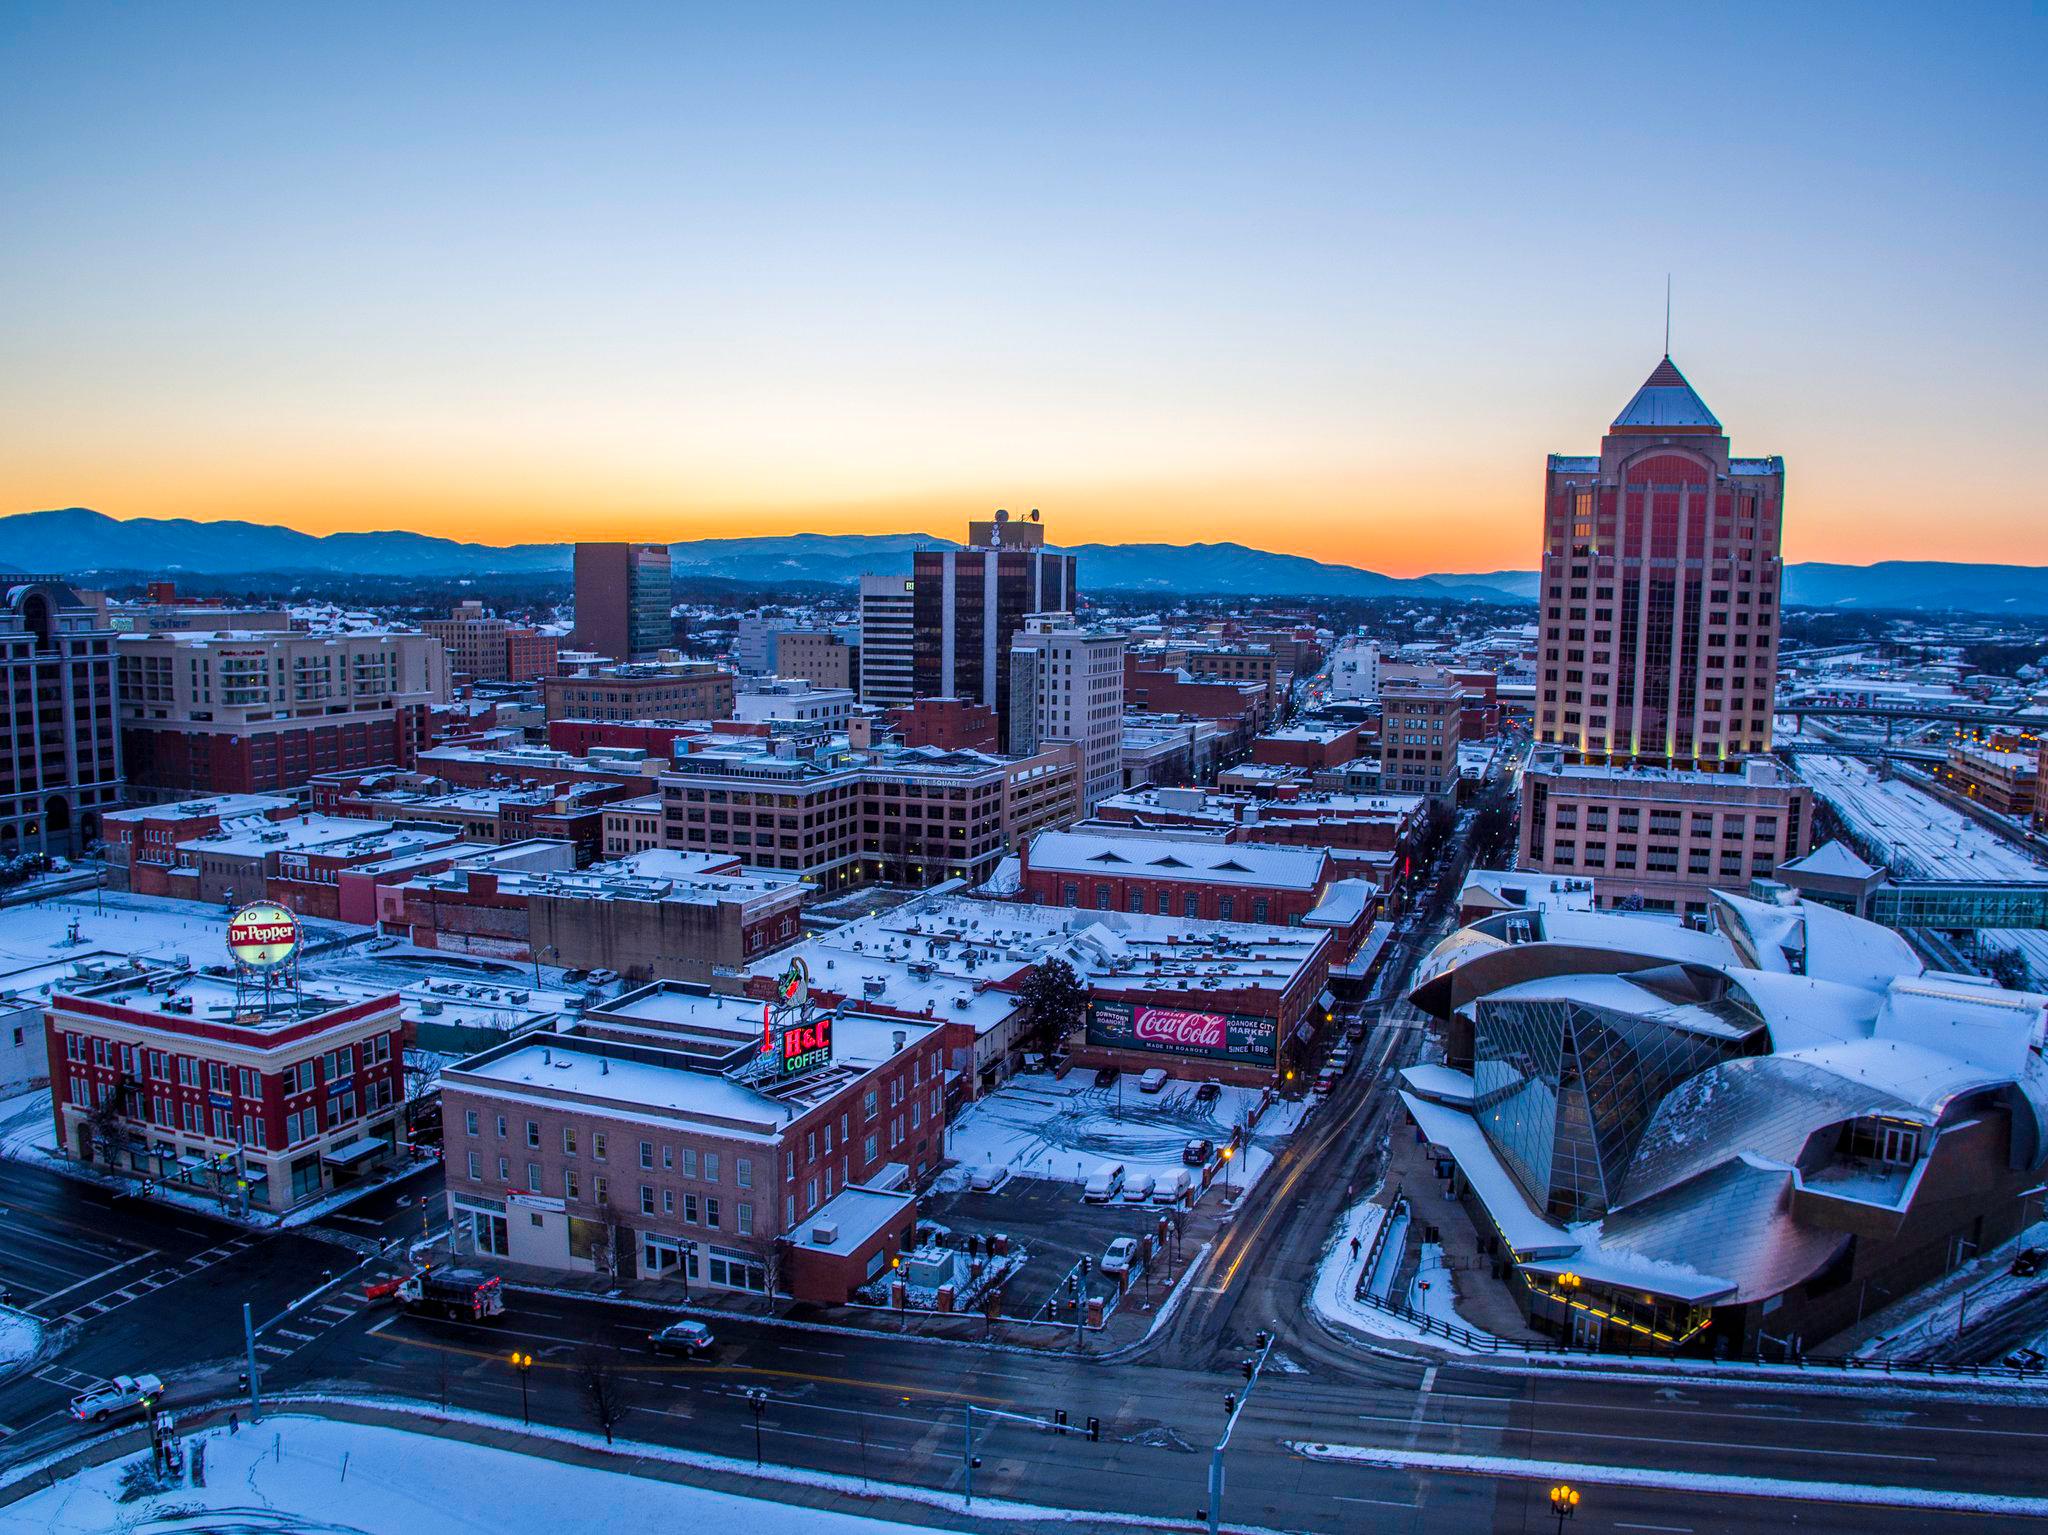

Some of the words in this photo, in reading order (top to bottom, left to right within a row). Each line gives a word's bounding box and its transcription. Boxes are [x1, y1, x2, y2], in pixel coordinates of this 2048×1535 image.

[243, 912, 257, 921] 10
[274, 912, 281, 920] 2
[231, 929, 248, 942] Dr
[247, 925, 294, 943] Pepper
[258, 951, 266, 960] 4
[1104, 1005, 1123, 1013] Welcome
[1095, 1010, 1129, 1022] DOWNTOWN
[1097, 1017, 1126, 1027] ROANOKE
[1226, 1020, 1258, 1029] ROANOKE
[1259, 1022, 1275, 1032] CITY
[1229, 1026, 1271, 1037] MARKET
[1175, 1045, 1209, 1054] ROANOKE
[1228, 1045, 1249, 1053] SINCE
[1251, 1045, 1269, 1054] 1882
[787, 1047, 829, 1071] COFFEE
